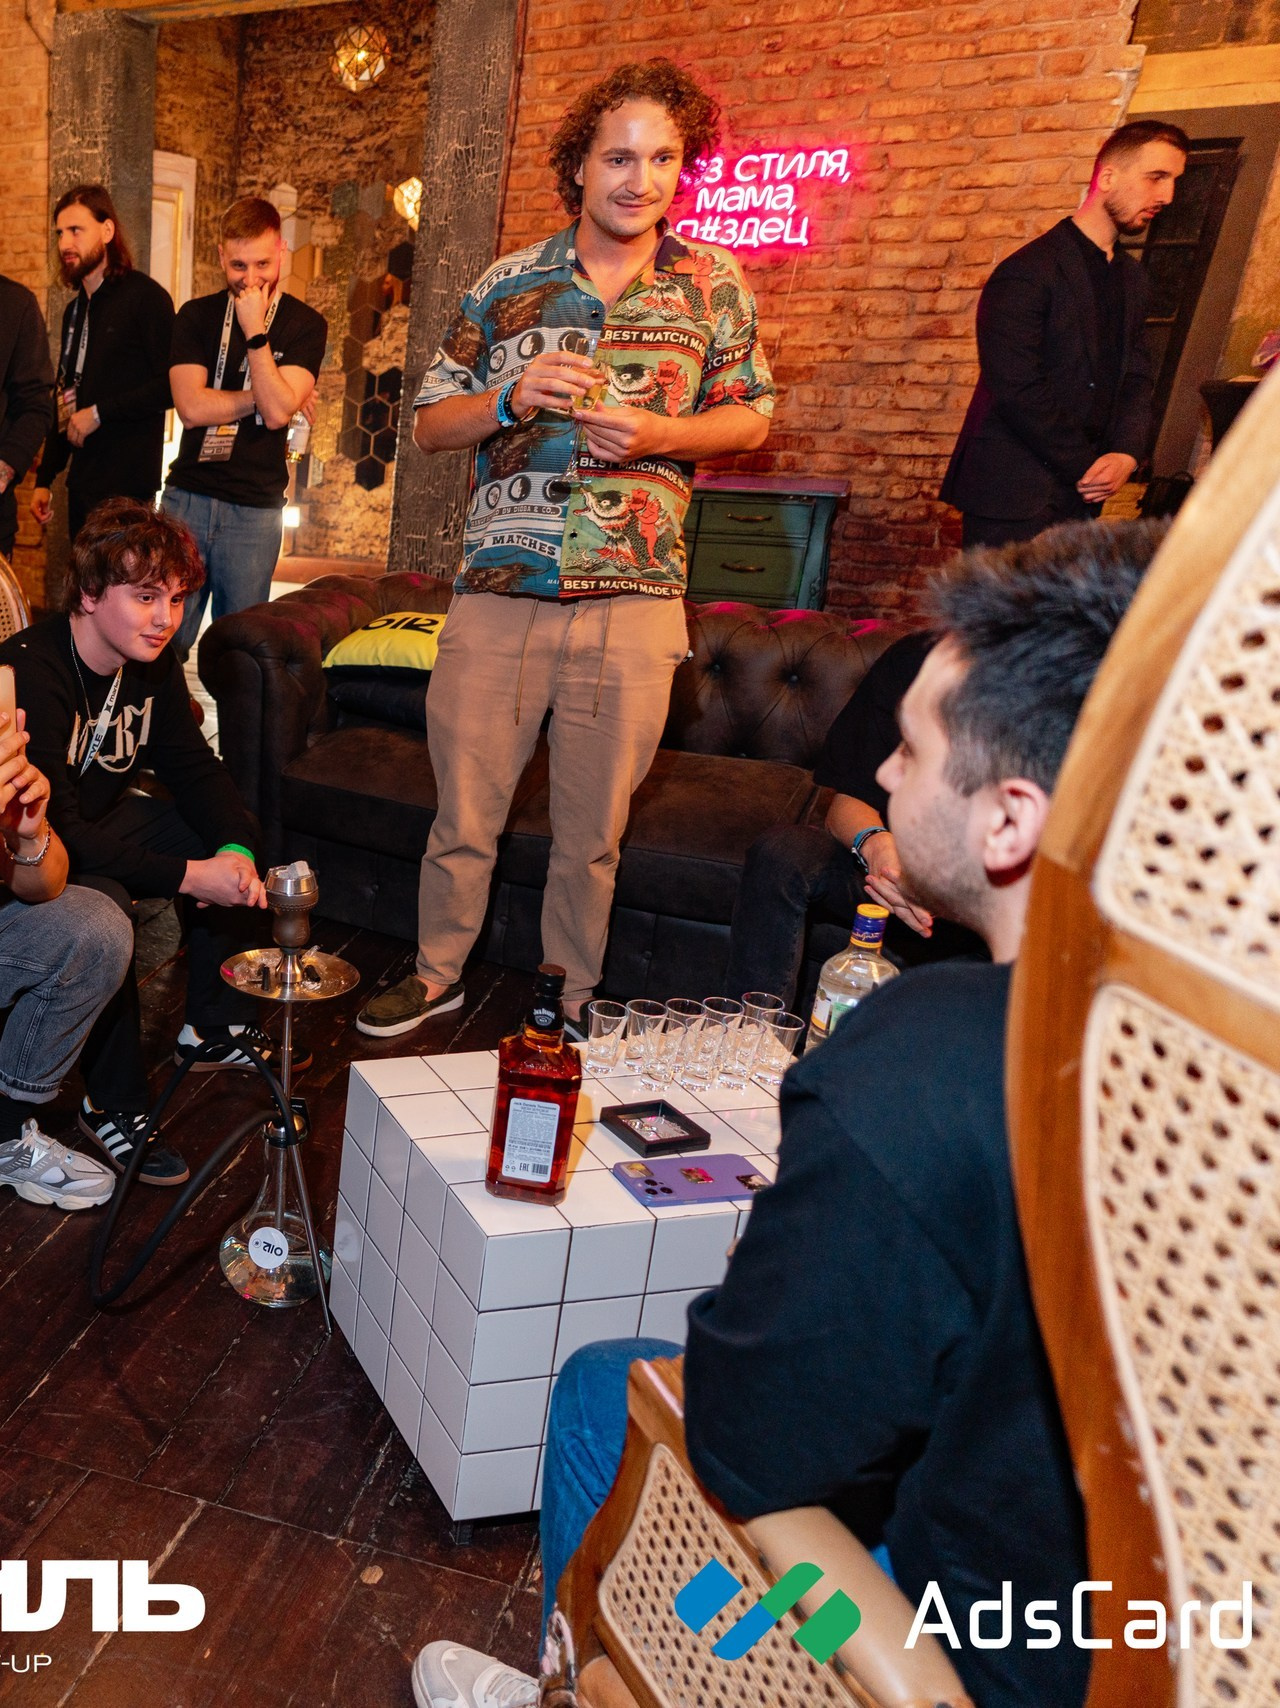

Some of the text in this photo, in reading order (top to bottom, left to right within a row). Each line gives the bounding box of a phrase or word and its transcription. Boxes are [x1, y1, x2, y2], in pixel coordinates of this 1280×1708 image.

[604, 330, 641, 342] BEST
[642, 331, 689, 346] MATCH
[492, 534, 557, 557] MATCHES
[563, 580, 597, 590] BEST
[599, 580, 638, 591] MATCH
[639, 583, 671, 596] MADE
